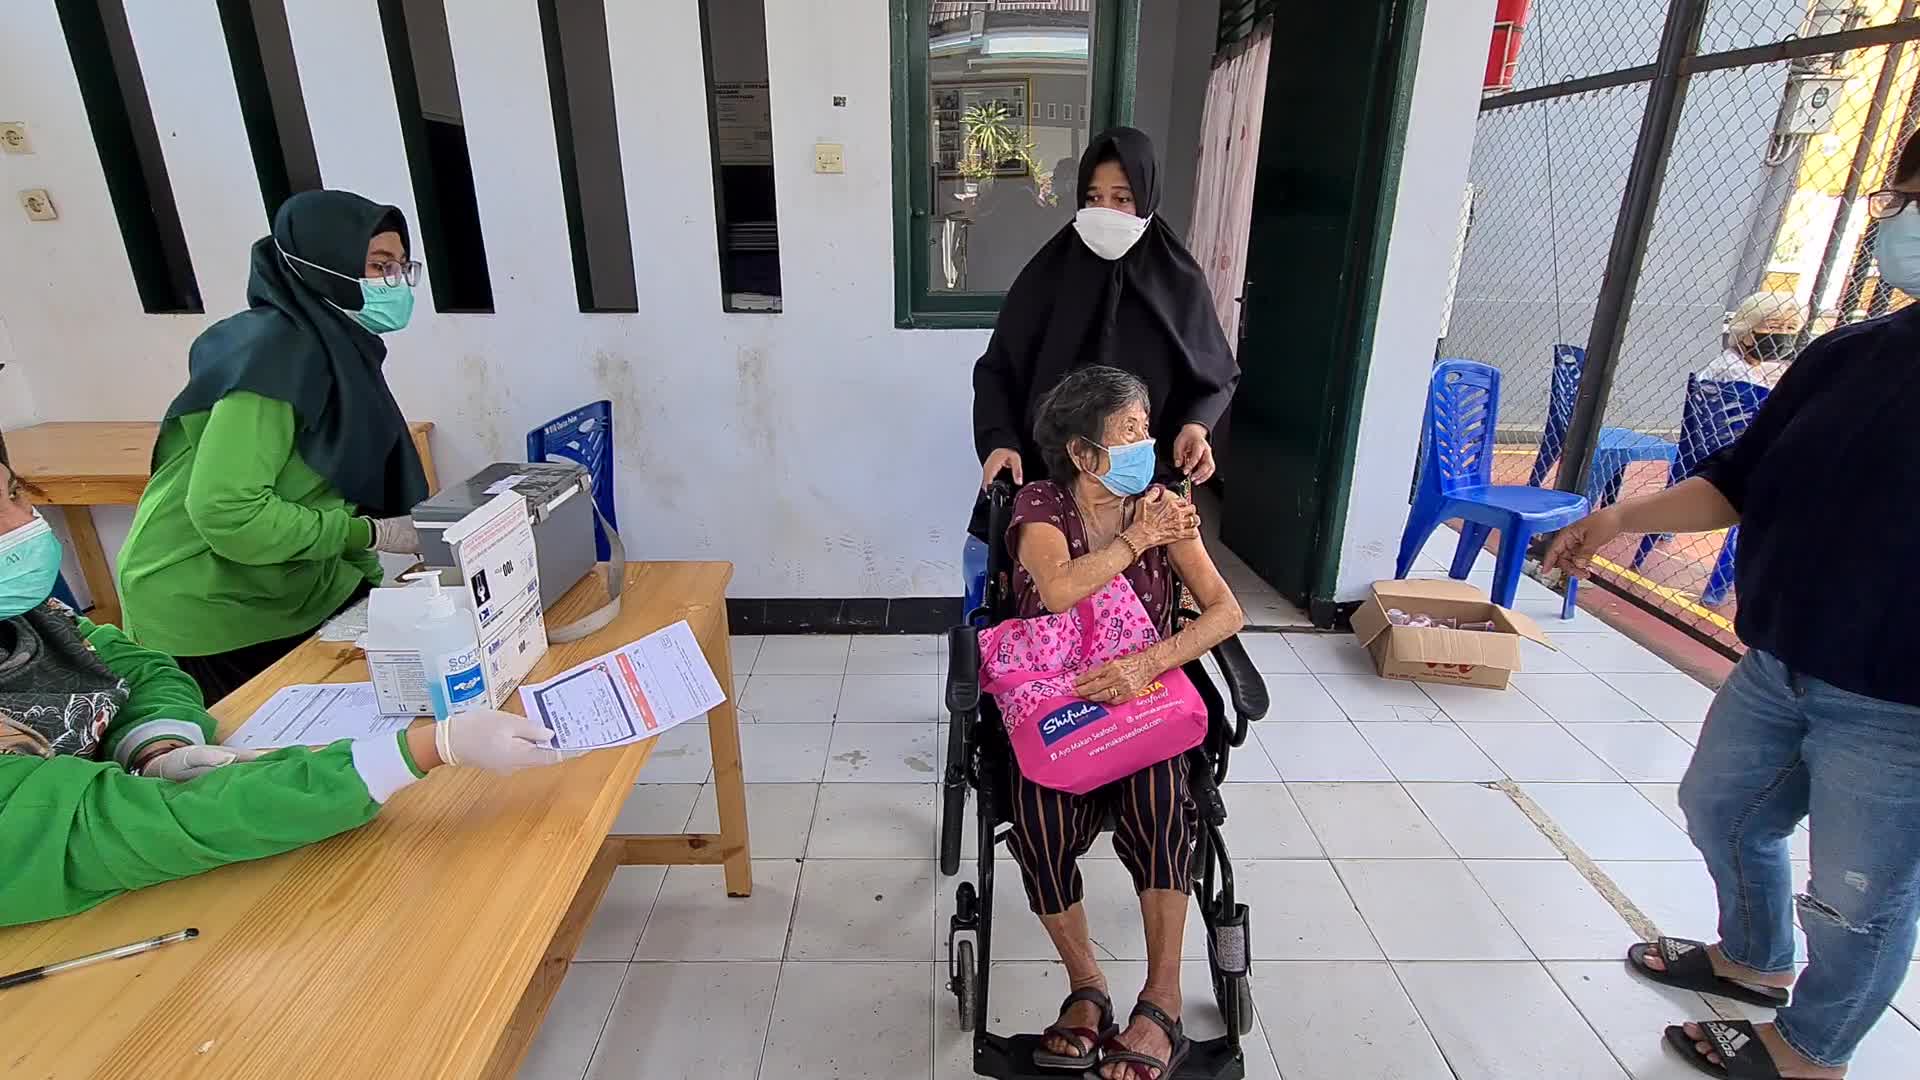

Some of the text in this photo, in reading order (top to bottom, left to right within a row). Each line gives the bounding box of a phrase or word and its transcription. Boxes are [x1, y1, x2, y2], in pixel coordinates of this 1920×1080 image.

[1058, 723, 1118, 759] Ayo Makan Seafood
[1088, 717, 1163, 757] www.makanseafood.com
[1706, 1022, 1736, 1058] adidas
